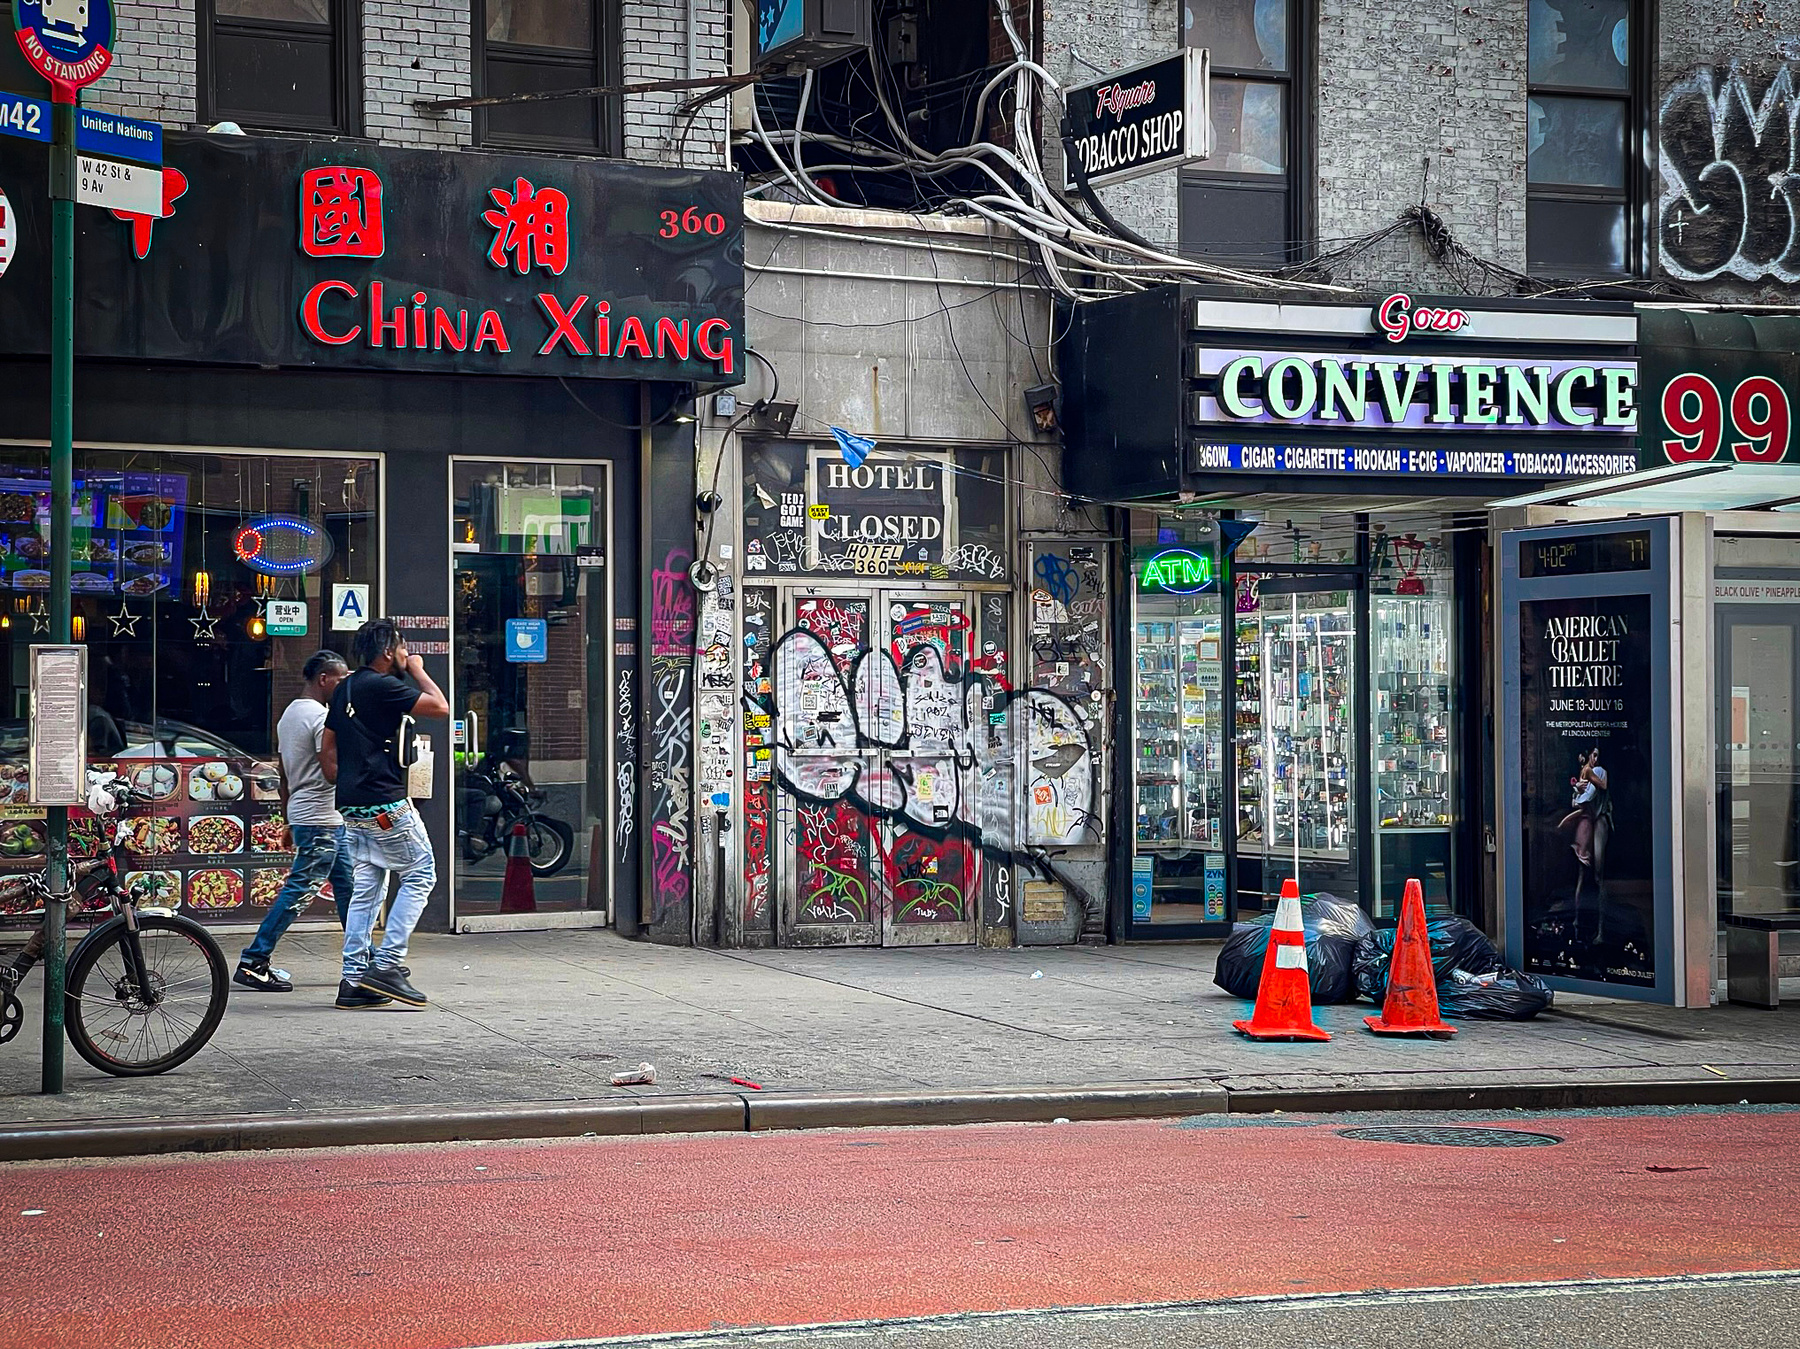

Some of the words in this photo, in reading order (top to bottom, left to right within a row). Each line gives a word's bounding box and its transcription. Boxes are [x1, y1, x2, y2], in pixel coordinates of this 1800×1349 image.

[25, 34, 43, 60] NO
[43, 50, 106, 80] STANDING
[81, 114, 114, 134] United
[116, 122, 154, 142] Nations
[1074, 123, 1139, 174] OBACCO
[1140, 110, 1183, 159] SHOP
[81, 160, 93, 174] W
[95, 163, 108, 177] 42
[110, 165, 121, 180] St
[123, 169, 132, 182] &
[82, 179, 89, 192] 9
[91, 182, 104, 194] Av
[659, 207, 726, 239] 360
[1378, 292, 1471, 343] Gozo
[1219, 355, 1639, 428] CONVIENCE
[1660, 373, 1791, 463] 99
[1241, 446, 1276, 468] CIGAR
[1284, 447, 1346, 470] CIGARETTE
[1354, 449, 1401, 471] HOOKAH
[1408, 451, 1438, 473] E-CIG
[1445, 452, 1505, 473] VAPORIZER
[1513, 453, 1562, 475] TOBACCO
[1564, 454, 1636, 475] ACCESSORIES
[826, 463, 935, 490] HOTEL
[780, 492, 804, 504] TEDZ
[780, 504, 804, 516] GOT
[780, 516, 804, 528] GAME
[818, 514, 941, 541] CLOSED
[846, 544, 902, 560] HOTEL
[1538, 546, 1567, 568] 4:02
[856, 560, 889, 574] 360
[1142, 557, 1211, 587] ATM
[338, 589, 362, 618] A
[1714, 586, 1739, 597] BLACK
[1740, 586, 1760, 598] OLIVE
[275, 605, 300, 616] 营业中
[1544, 614, 1630, 640] AMERICAN
[1551, 634, 1621, 663] BALLET
[1548, 664, 1624, 689] THEATRE
[1550, 698, 1574, 712] JUNE
[1576, 698, 1613, 712] 13-JULY
[1614, 698, 1624, 711] 16
[1545, 720, 1555, 728] THE
[1206, 870, 1225, 879] ZYN
